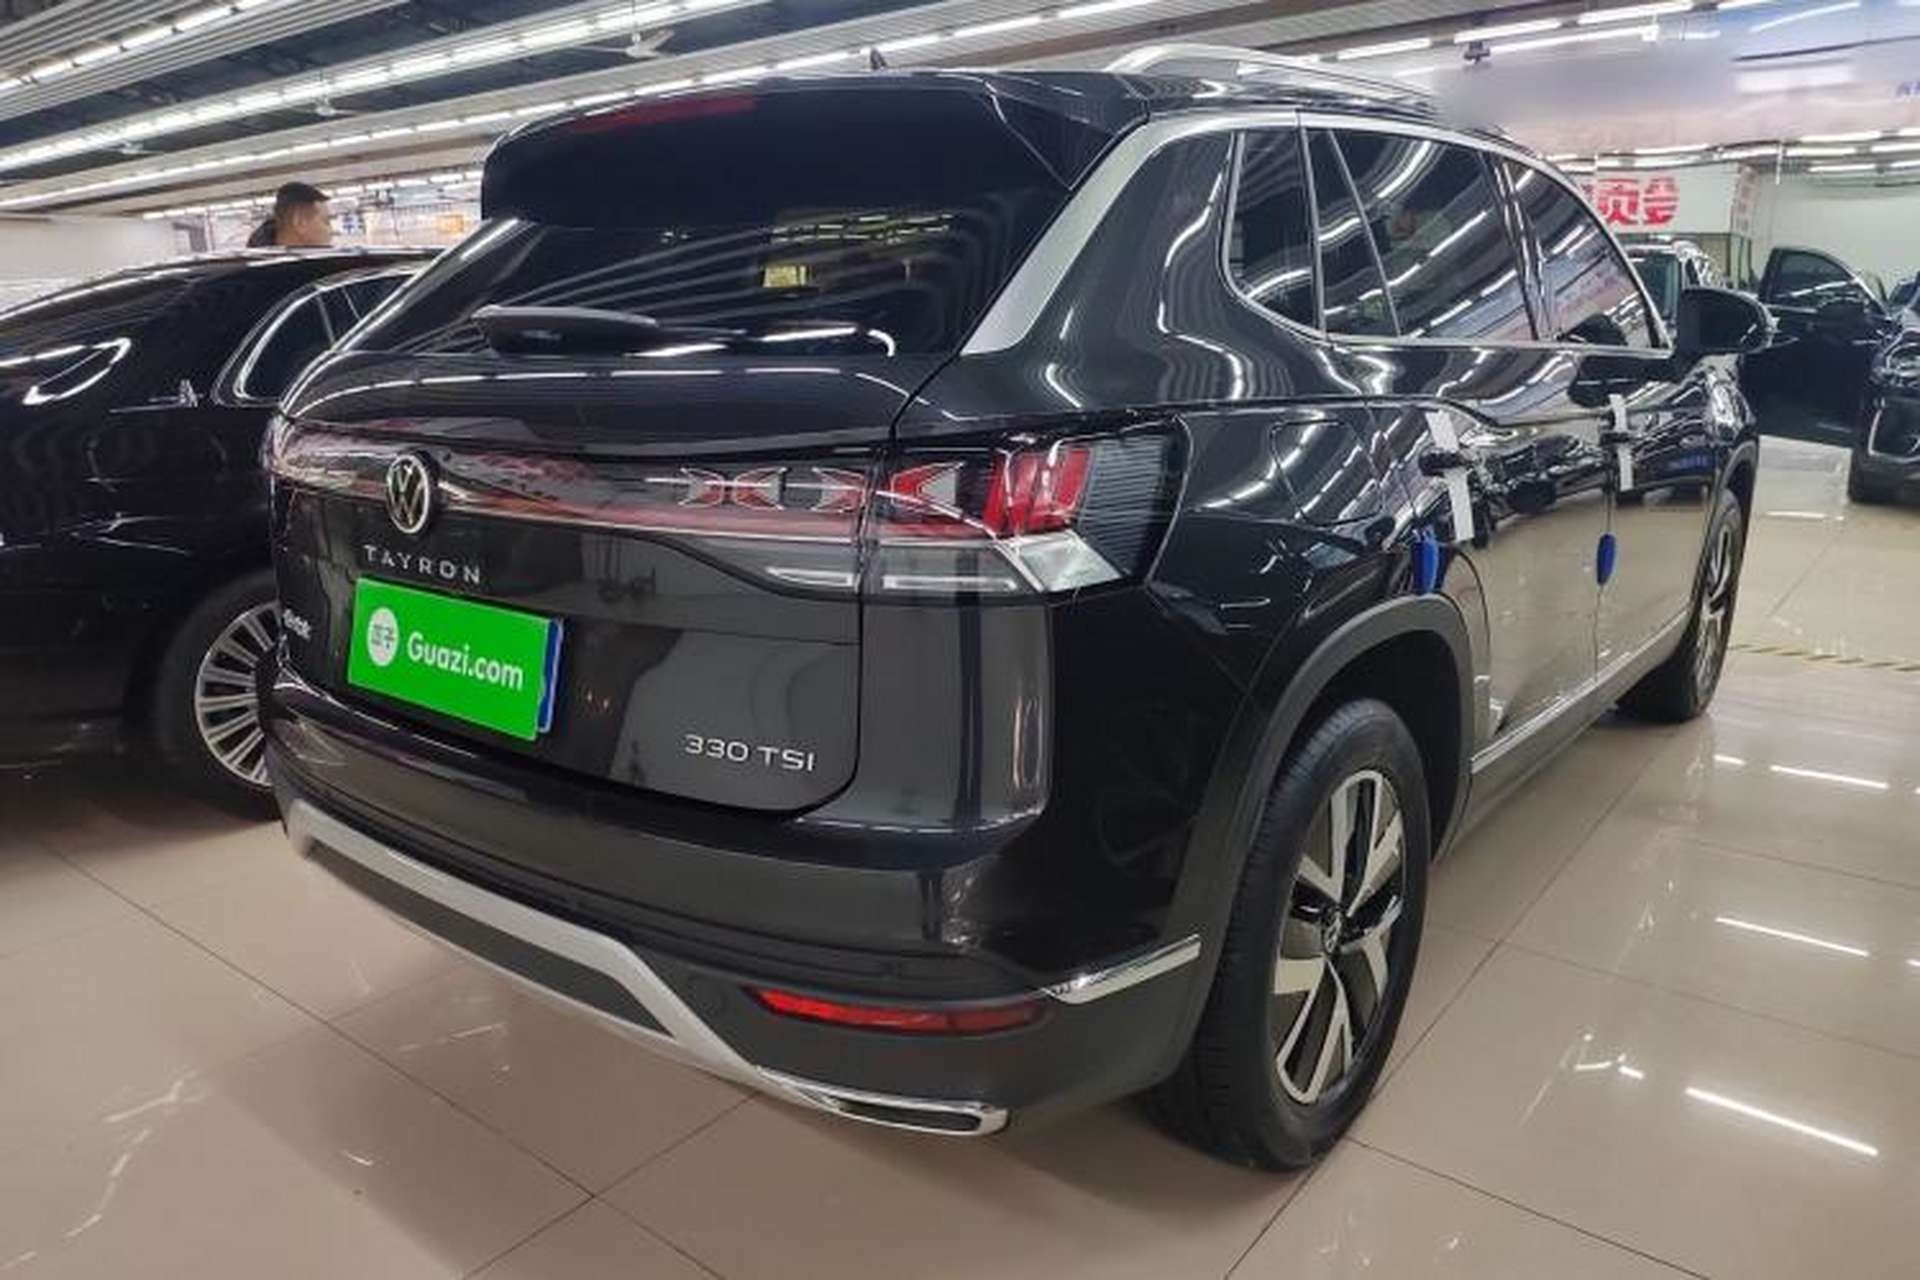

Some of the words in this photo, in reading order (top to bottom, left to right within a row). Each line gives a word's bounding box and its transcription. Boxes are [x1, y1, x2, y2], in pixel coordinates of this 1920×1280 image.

[363, 544, 481, 584] TAYRON
[685, 733, 750, 762] 330
[756, 745, 815, 772] TSI
